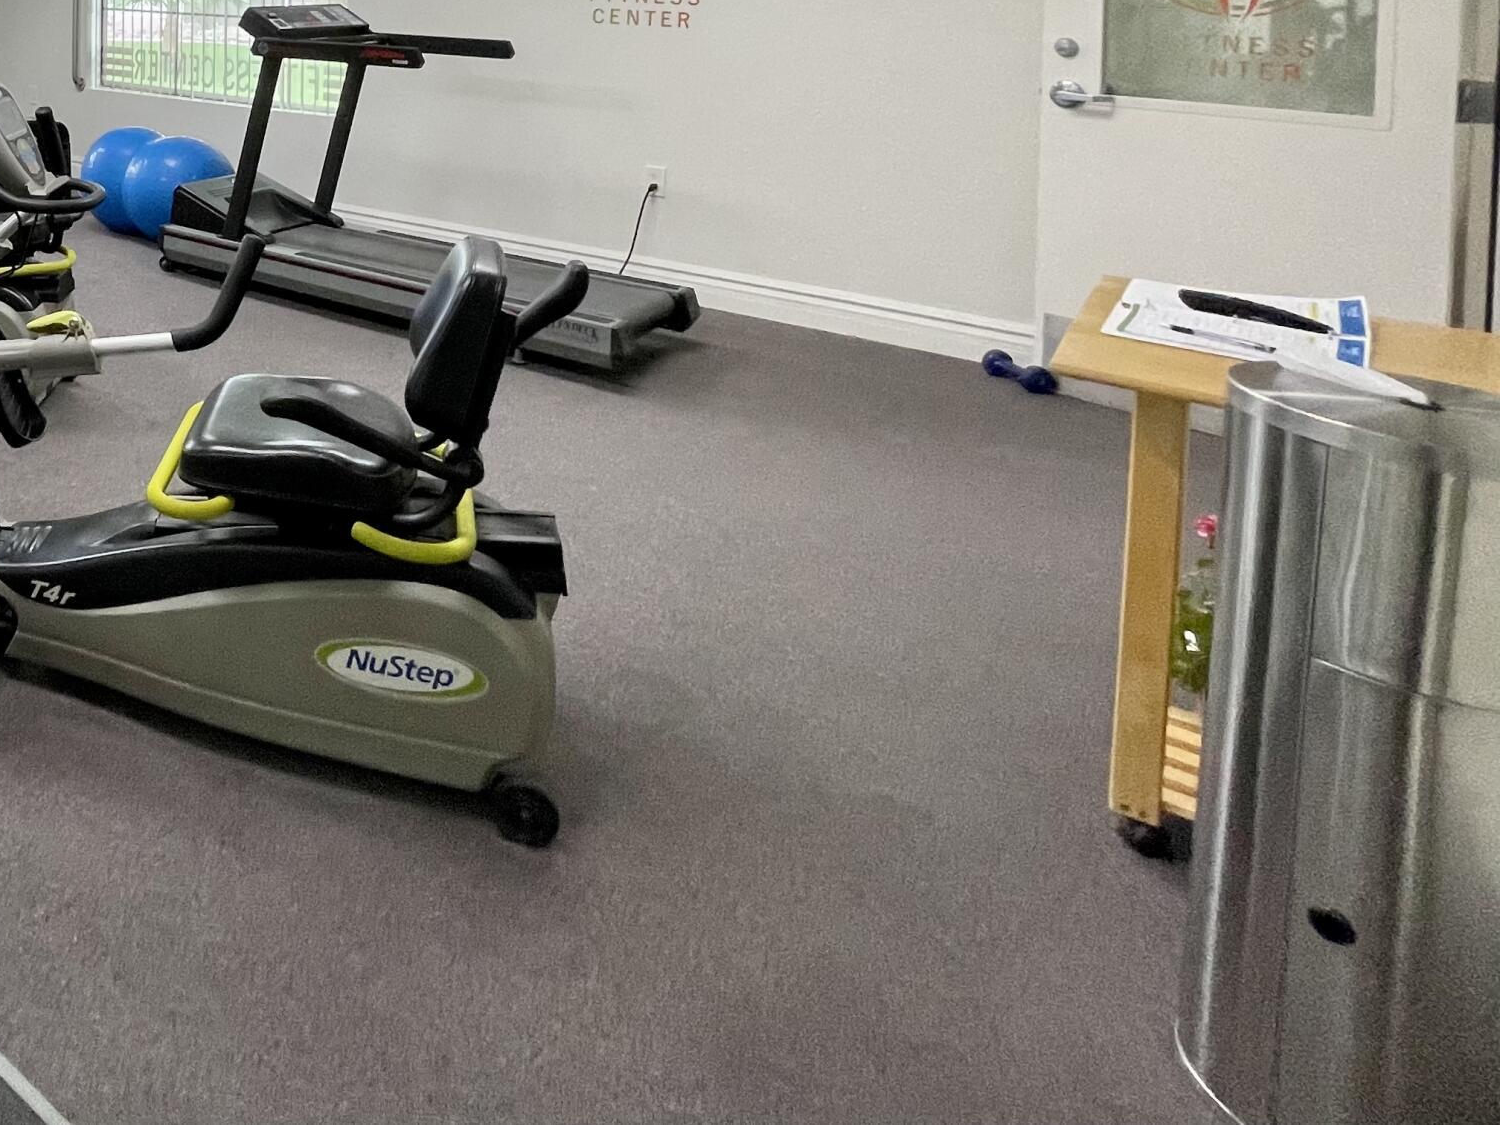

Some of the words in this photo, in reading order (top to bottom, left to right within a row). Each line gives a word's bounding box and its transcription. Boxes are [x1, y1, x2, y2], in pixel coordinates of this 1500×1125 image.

[592, 8, 691, 29] CENTER
[30, 580, 76, 605] T4r
[346, 649, 455, 689] NuStep
